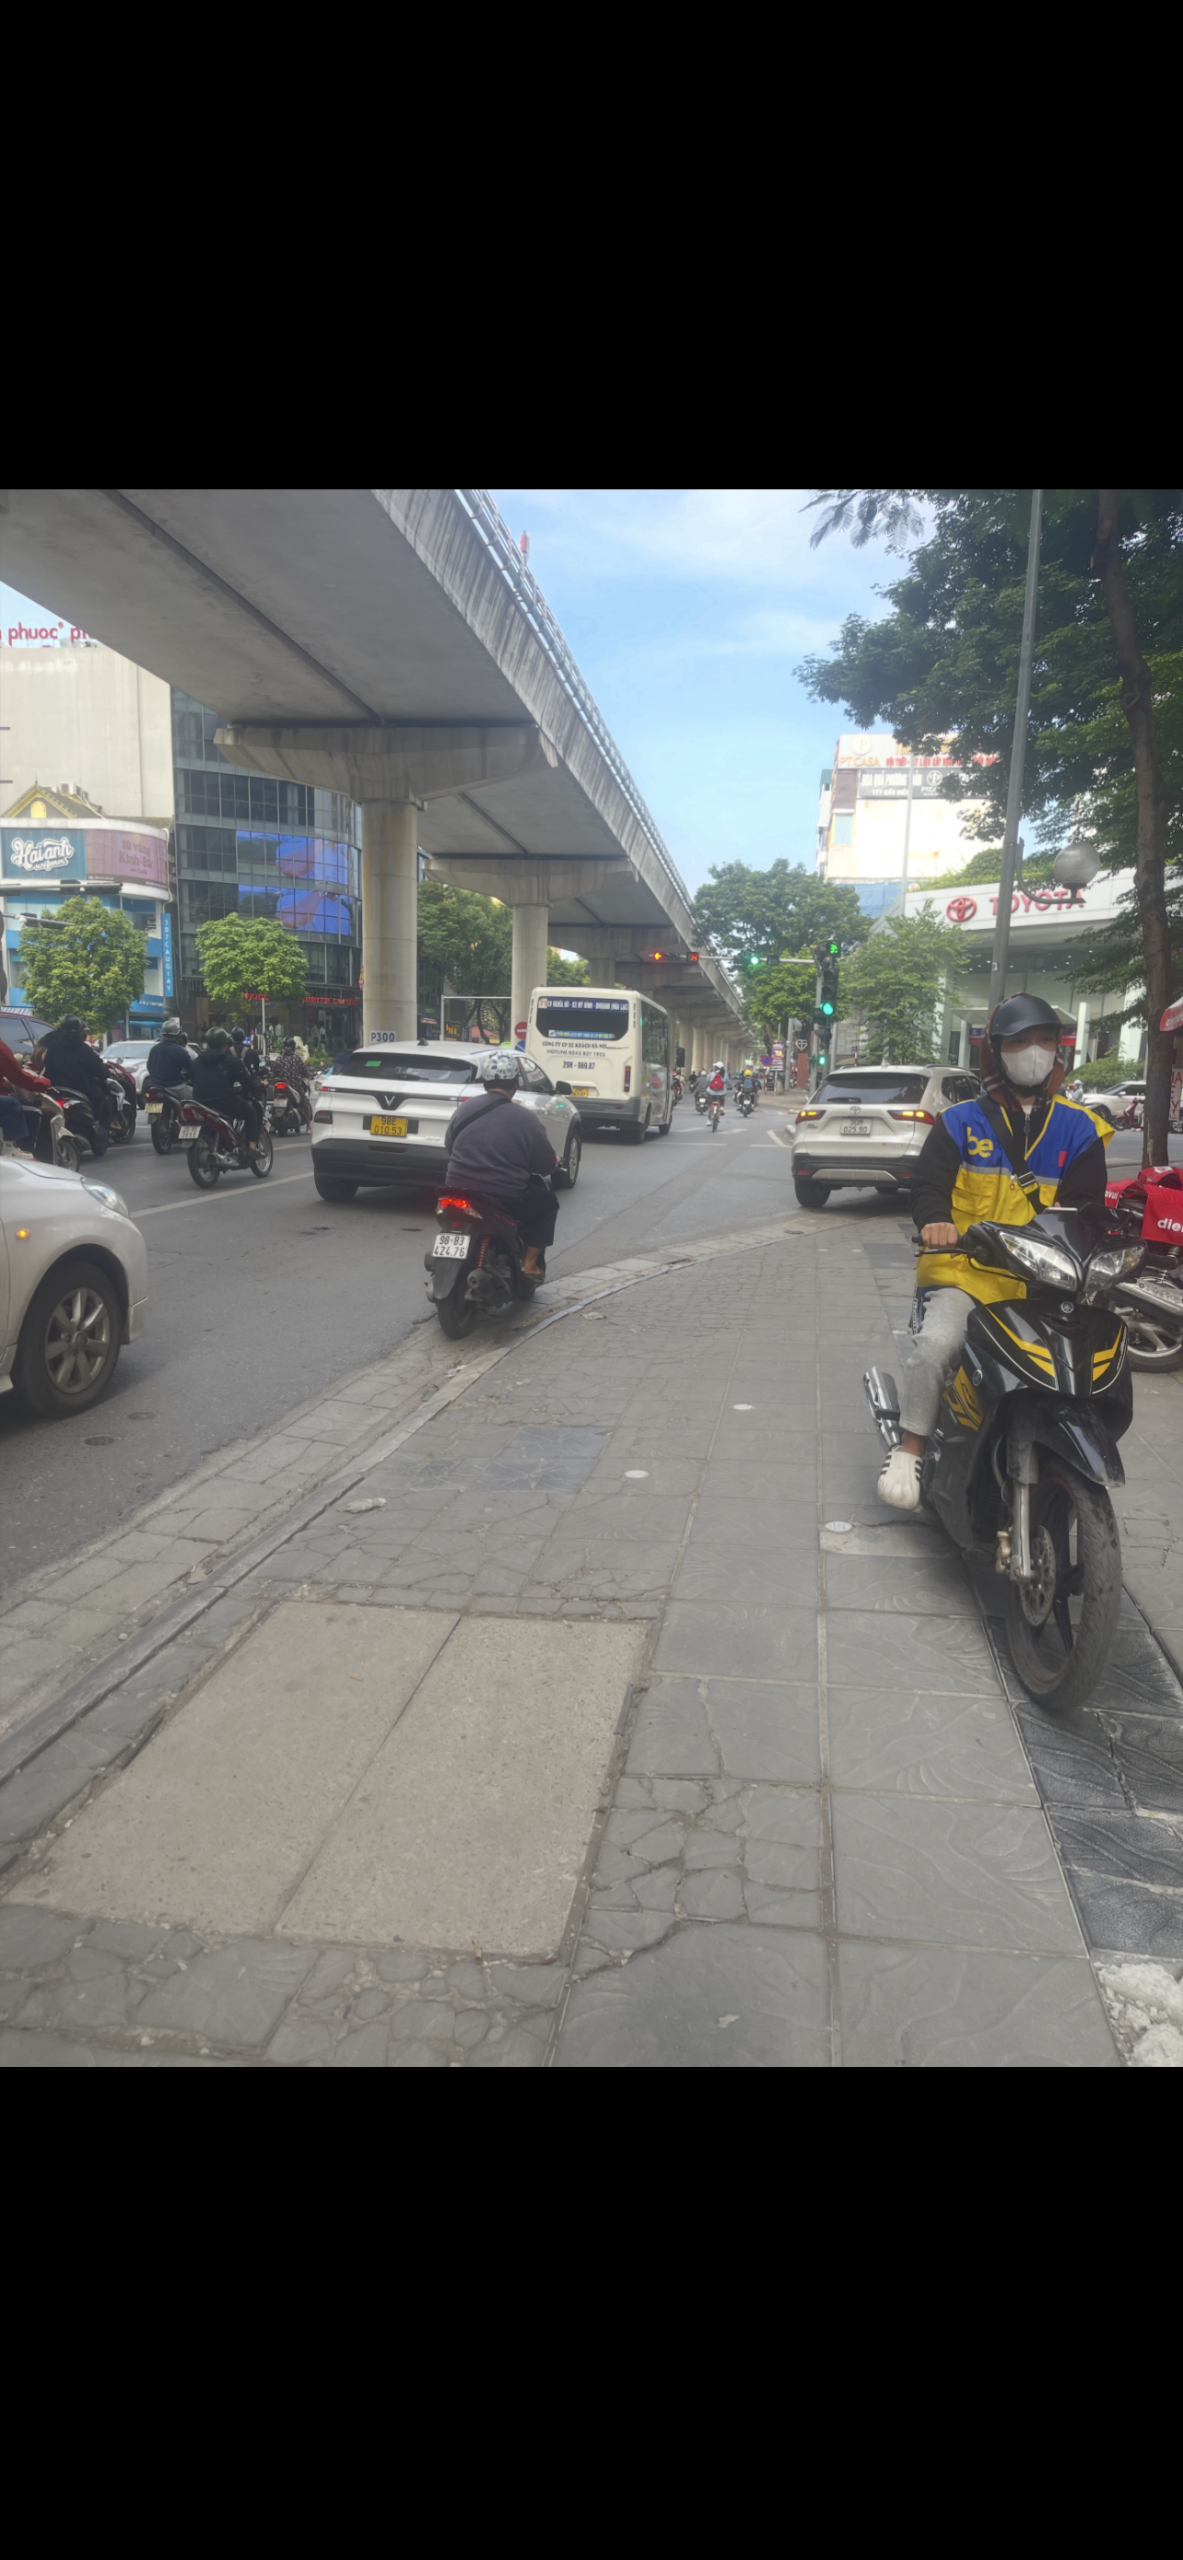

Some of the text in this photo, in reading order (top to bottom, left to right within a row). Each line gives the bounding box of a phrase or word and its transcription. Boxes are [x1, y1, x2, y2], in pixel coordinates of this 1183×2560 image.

[371, 1032, 395, 1042] P300
[966, 1126, 994, 1158] be
[1157, 1218, 1183, 1233] die
[433, 1246, 466, 1258] 424.76
